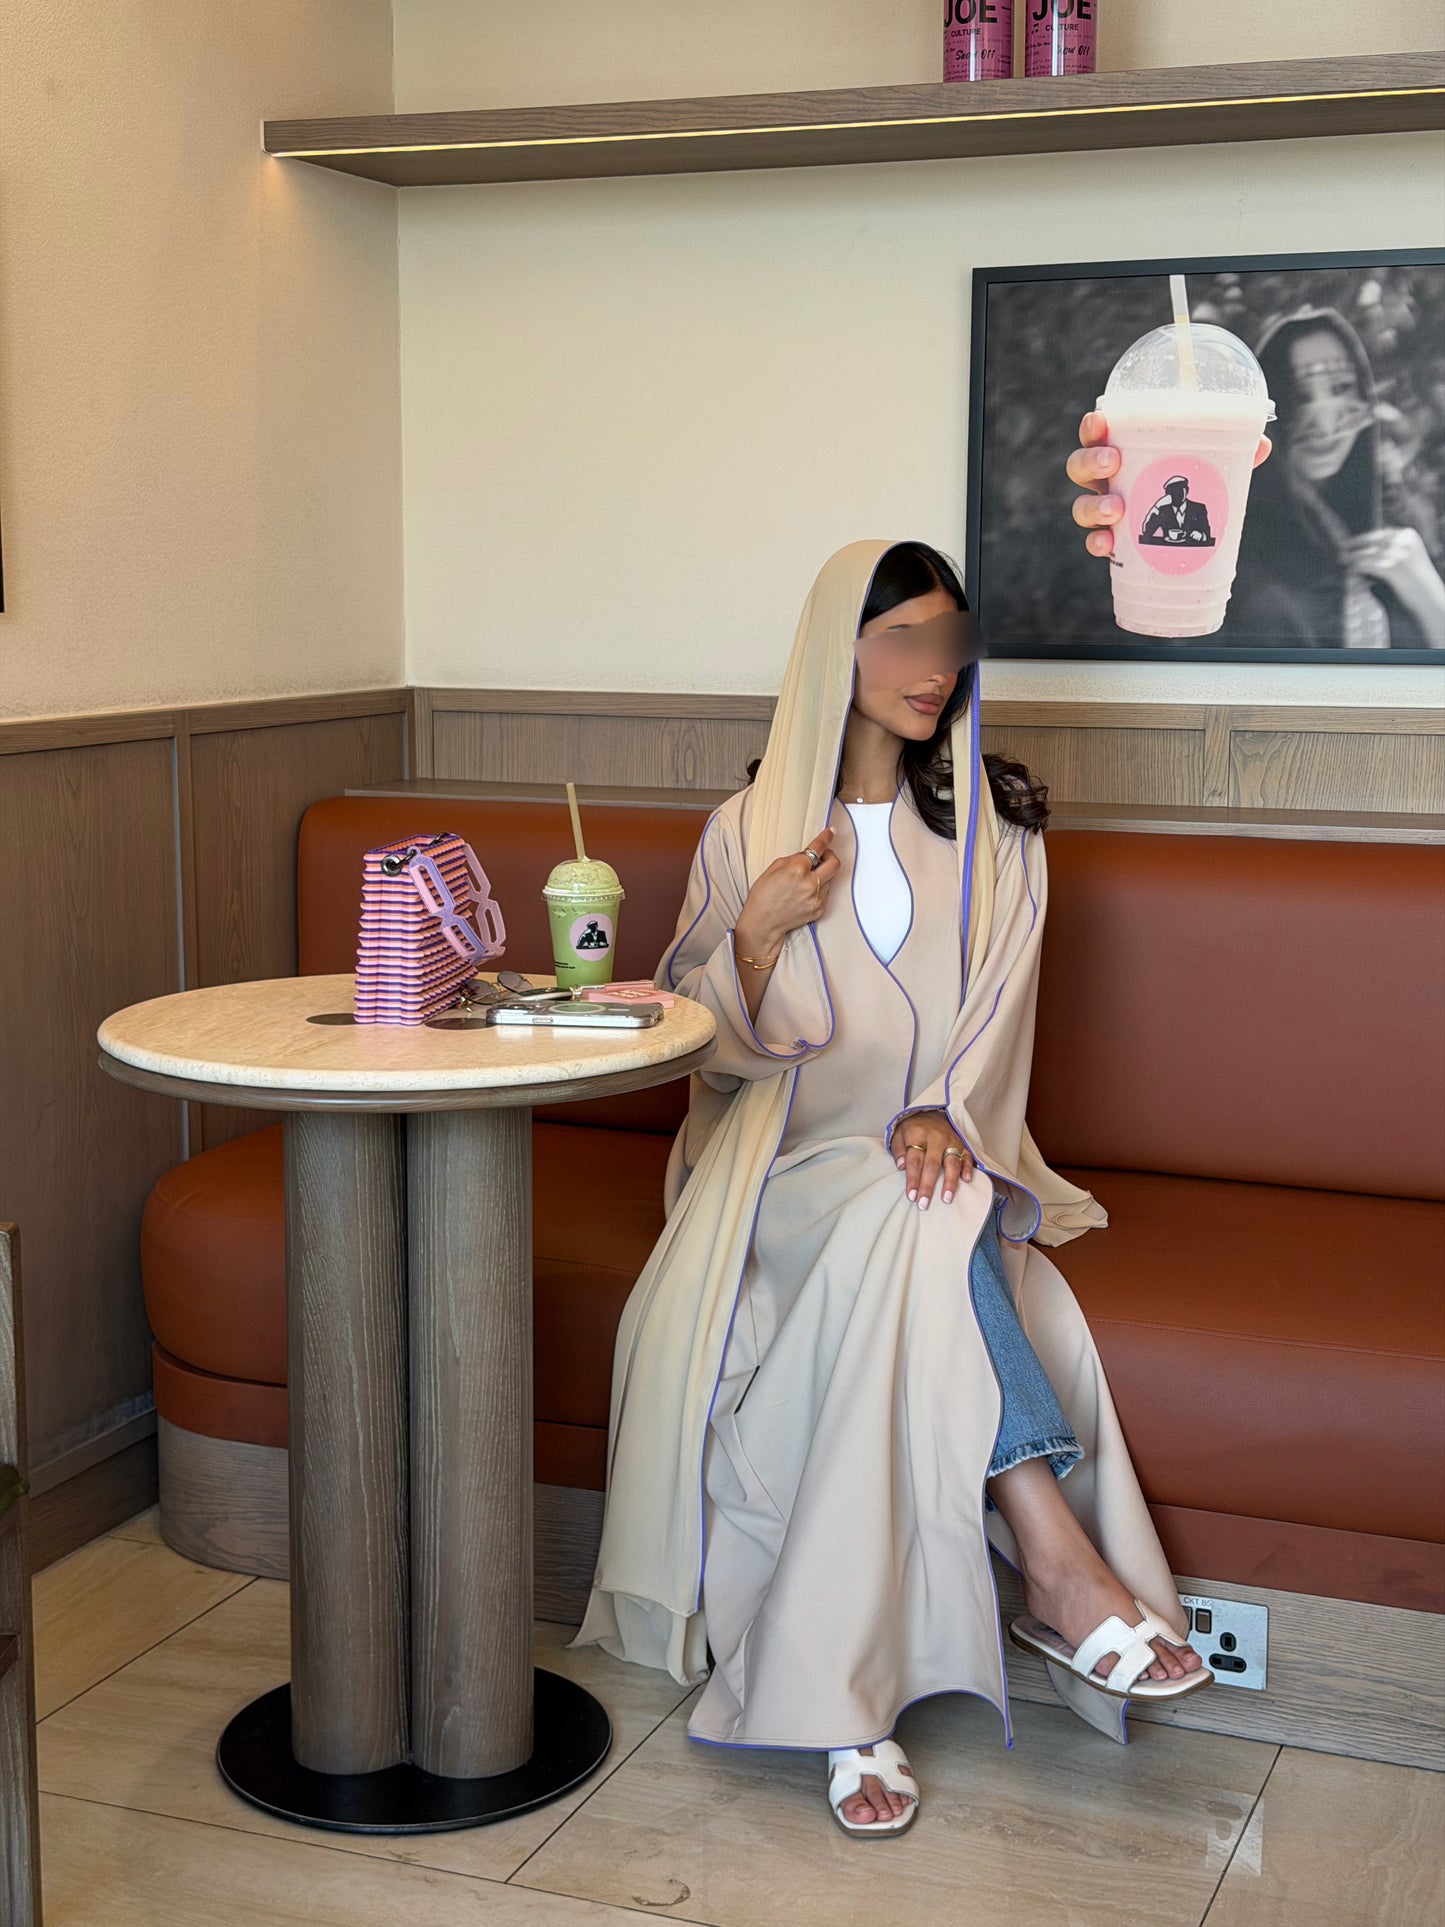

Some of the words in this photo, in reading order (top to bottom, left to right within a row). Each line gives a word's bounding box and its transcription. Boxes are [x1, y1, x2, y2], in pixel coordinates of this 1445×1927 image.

[944, 0, 998, 27] JOE
[1032, 0, 1092, 21] JOE
[951, 28, 981, 38] CULTURE
